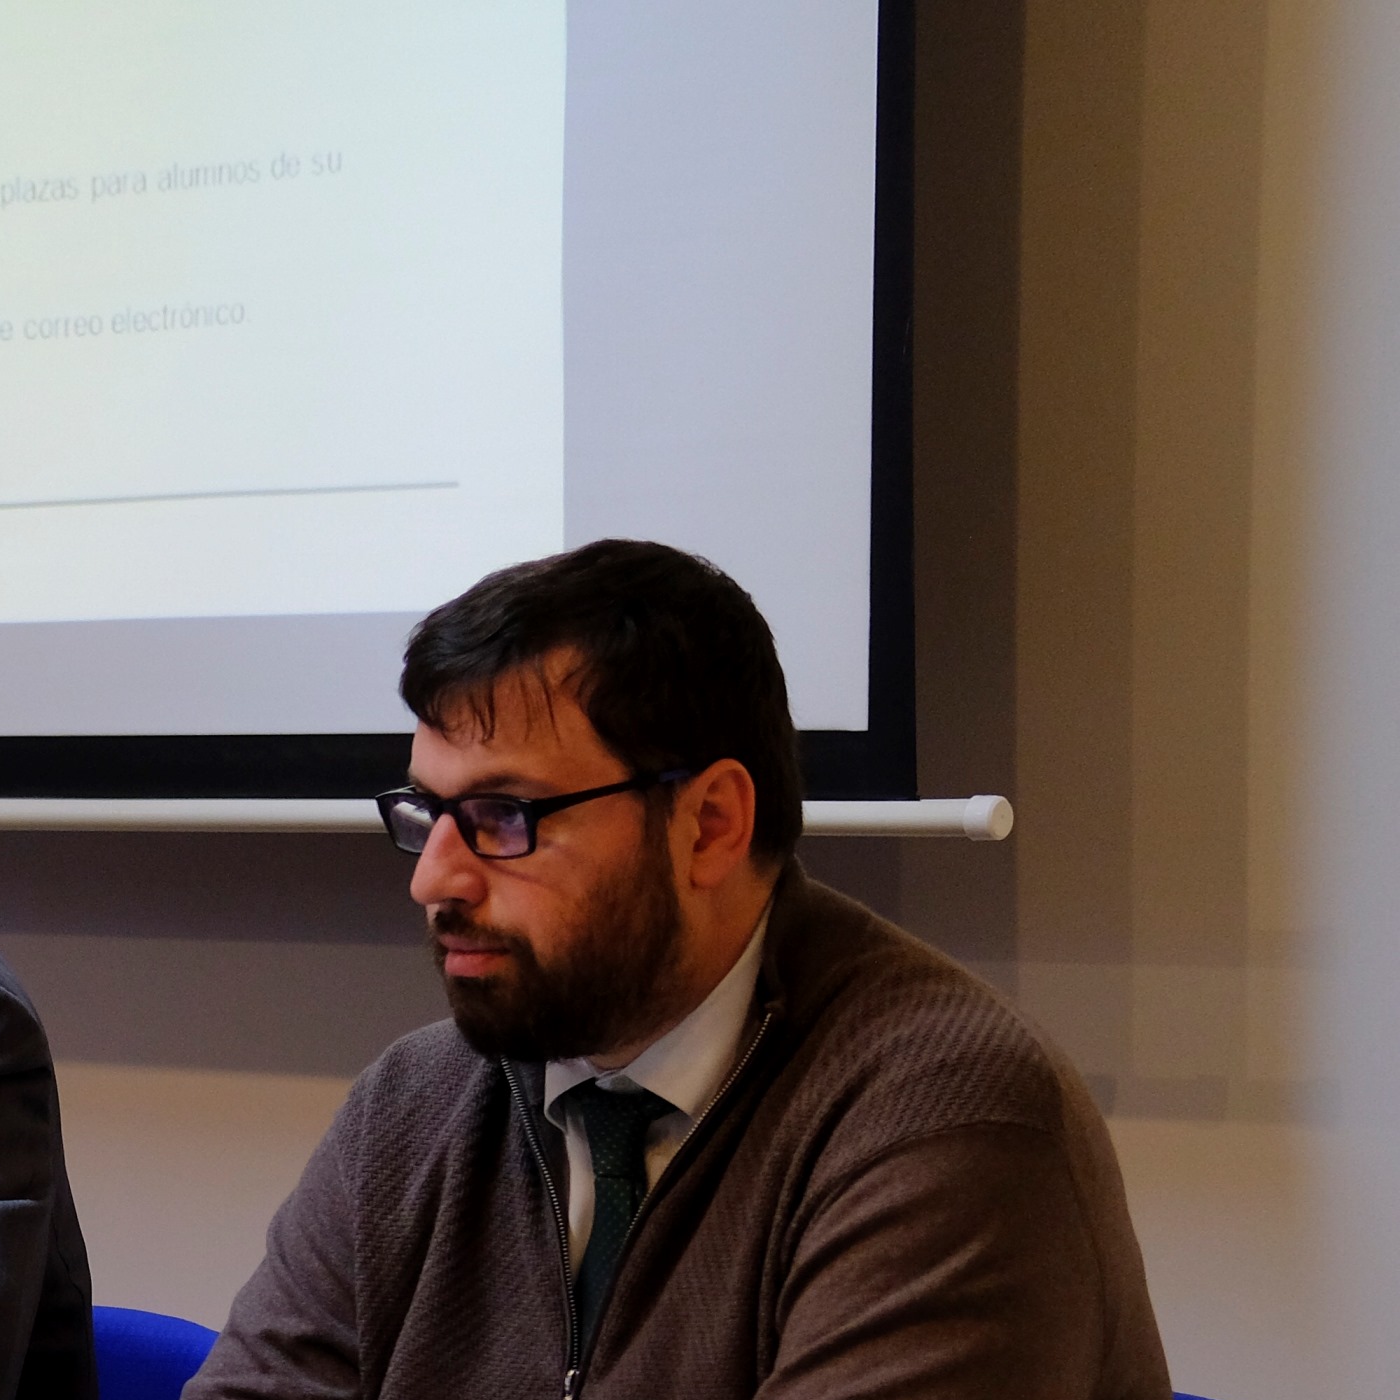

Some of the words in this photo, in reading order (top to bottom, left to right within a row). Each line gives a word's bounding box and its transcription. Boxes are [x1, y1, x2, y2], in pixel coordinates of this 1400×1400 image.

[0, 174, 80, 211] plazas
[90, 169, 148, 203] para
[157, 158, 261, 192] alumnos
[270, 151, 301, 178] de
[311, 149, 343, 176] su
[22, 311, 104, 341] correo
